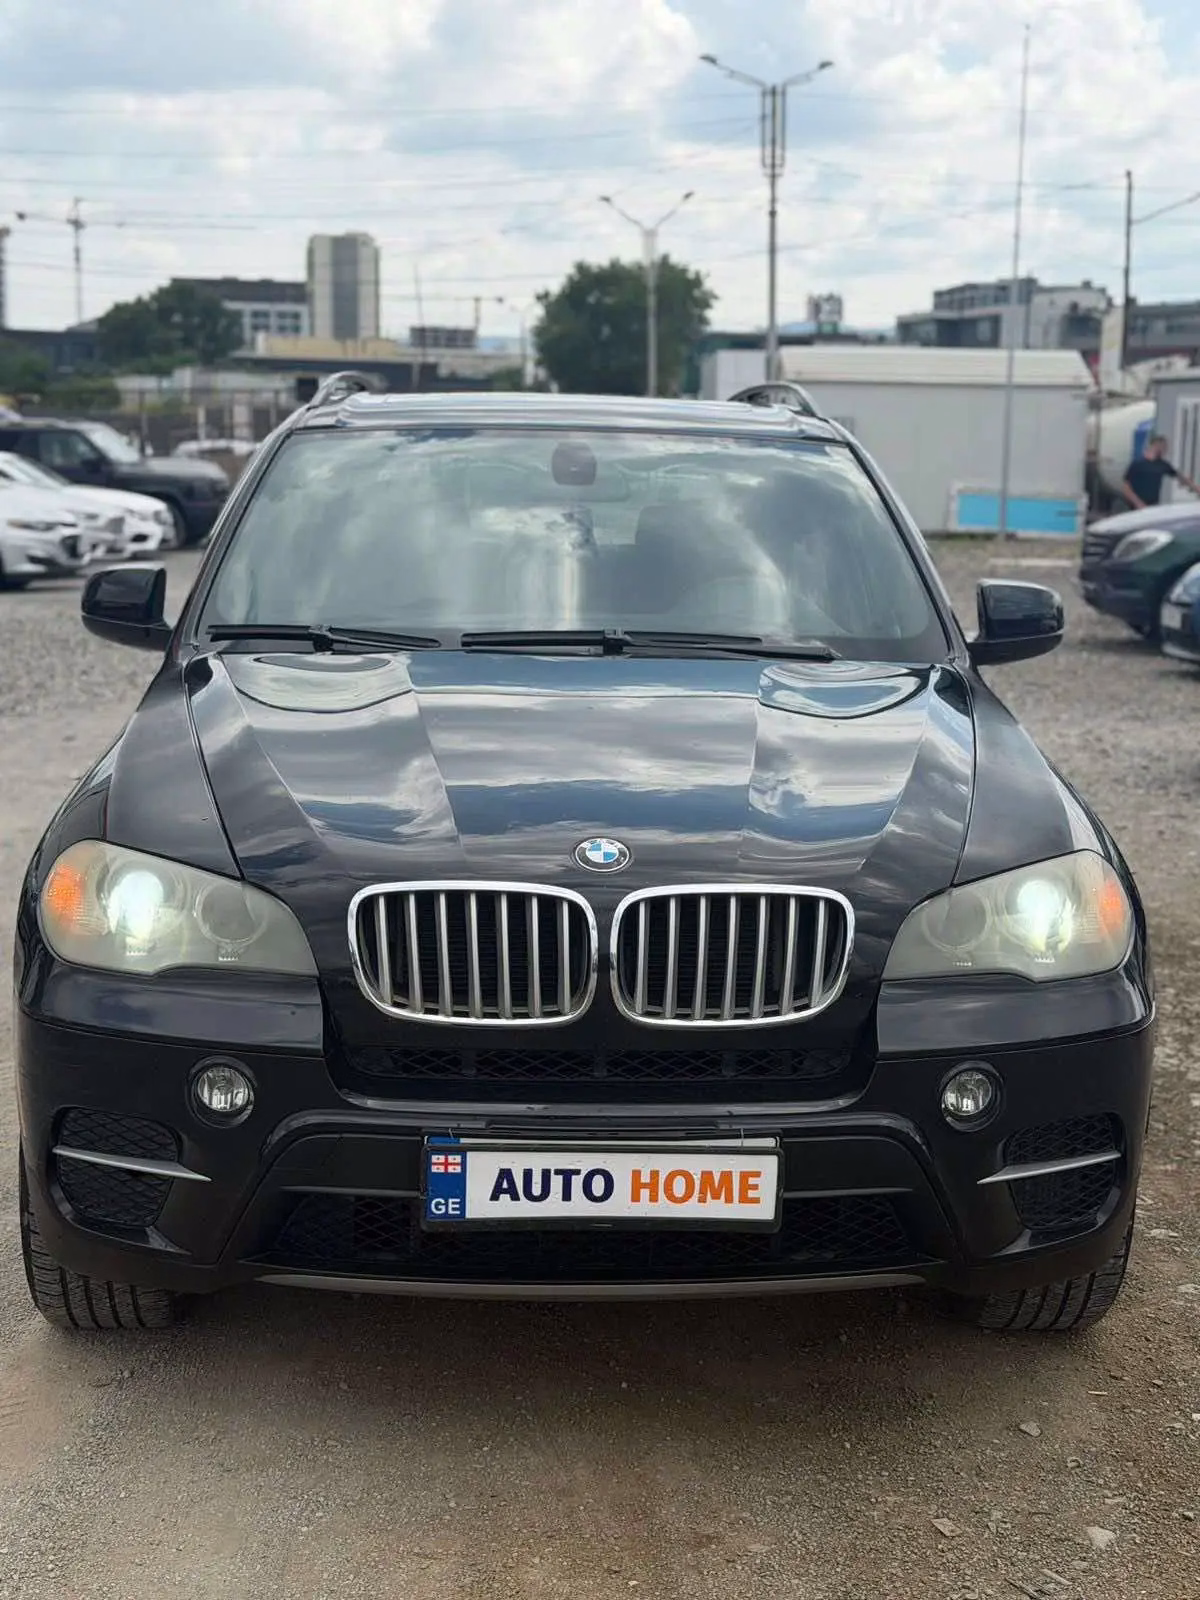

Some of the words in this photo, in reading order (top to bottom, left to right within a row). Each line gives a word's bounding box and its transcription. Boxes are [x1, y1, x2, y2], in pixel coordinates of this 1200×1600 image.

[489, 1168, 615, 1203] AUTO
[631, 1169, 762, 1205] HOME
[431, 1198, 461, 1214] GE
